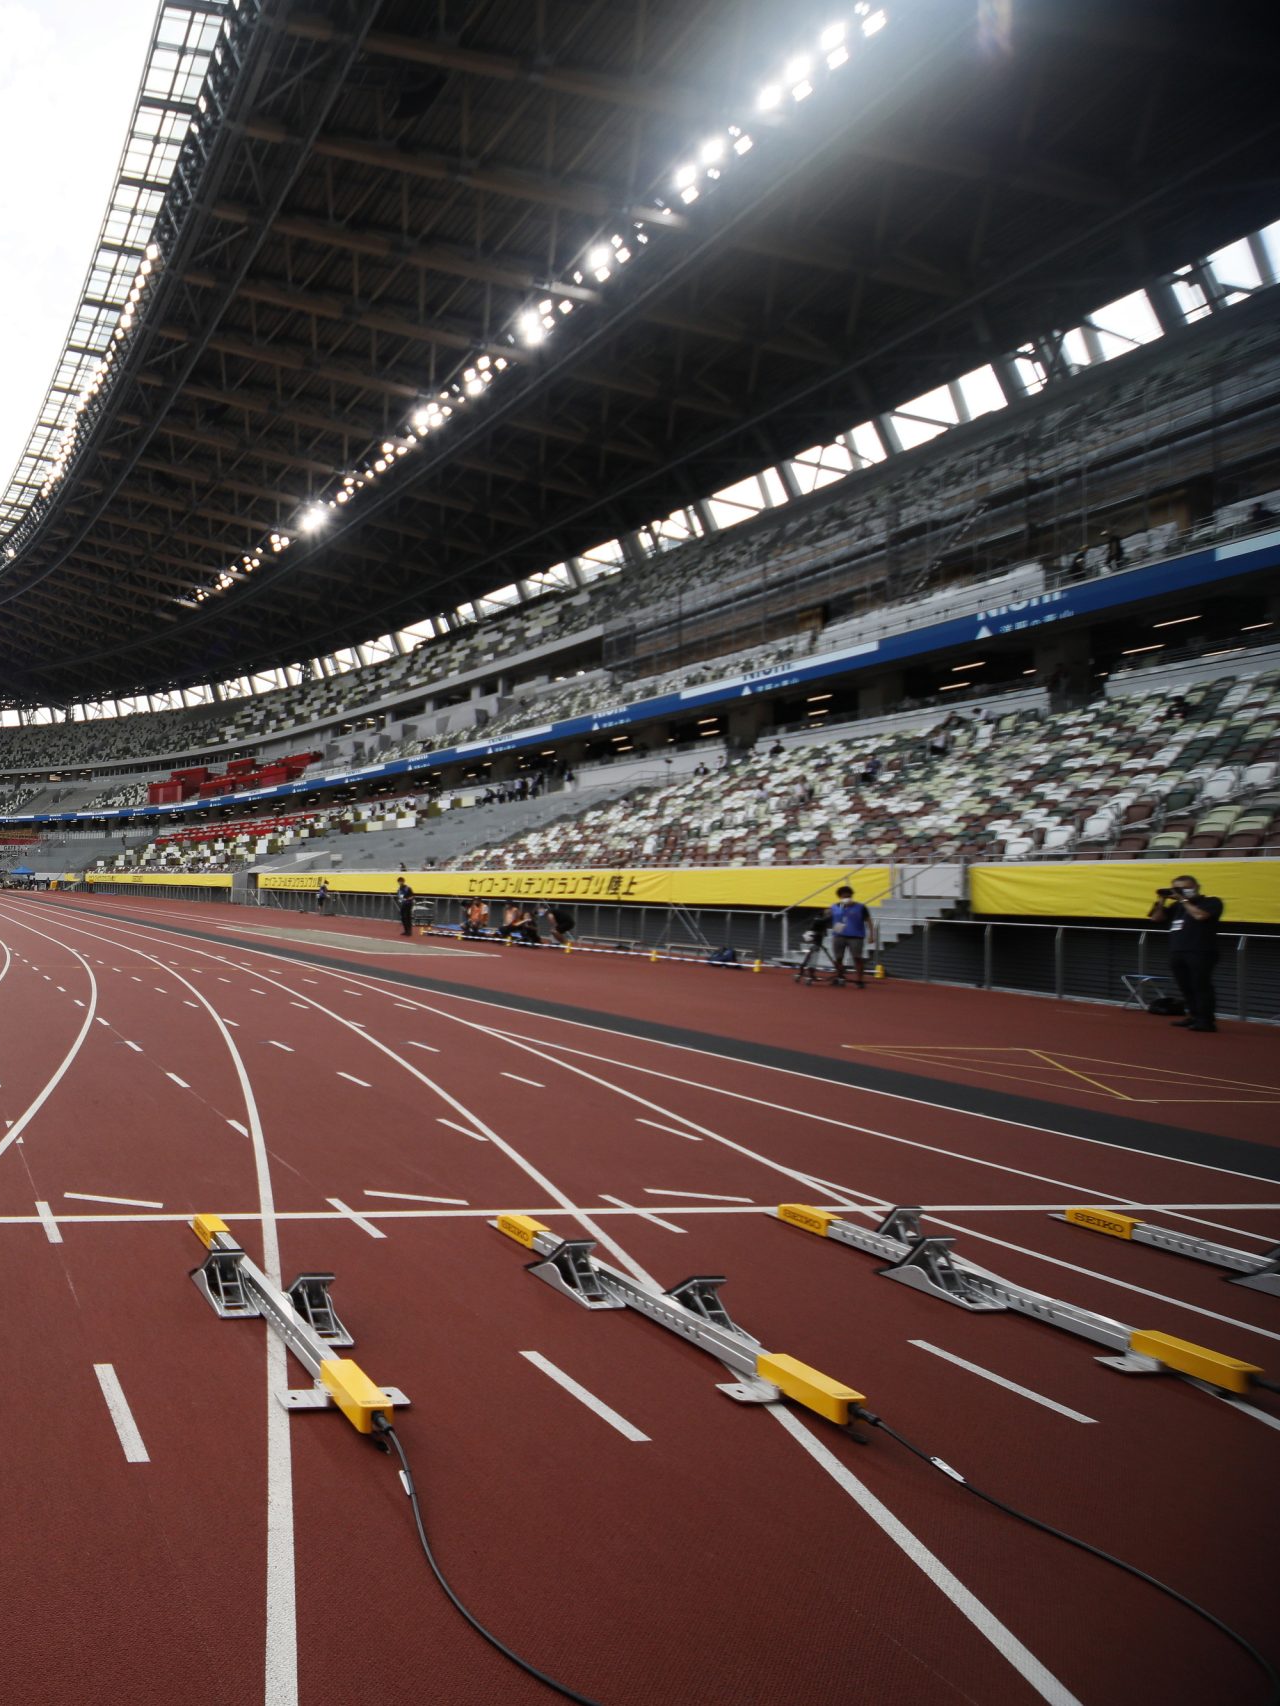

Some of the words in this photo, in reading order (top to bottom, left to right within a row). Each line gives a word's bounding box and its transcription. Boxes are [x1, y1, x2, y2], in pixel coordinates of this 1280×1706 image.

[783, 1209, 822, 1230] SEIKO
[1074, 1212, 1124, 1233] SEIKO
[501, 1219, 530, 1242] SEIKO
